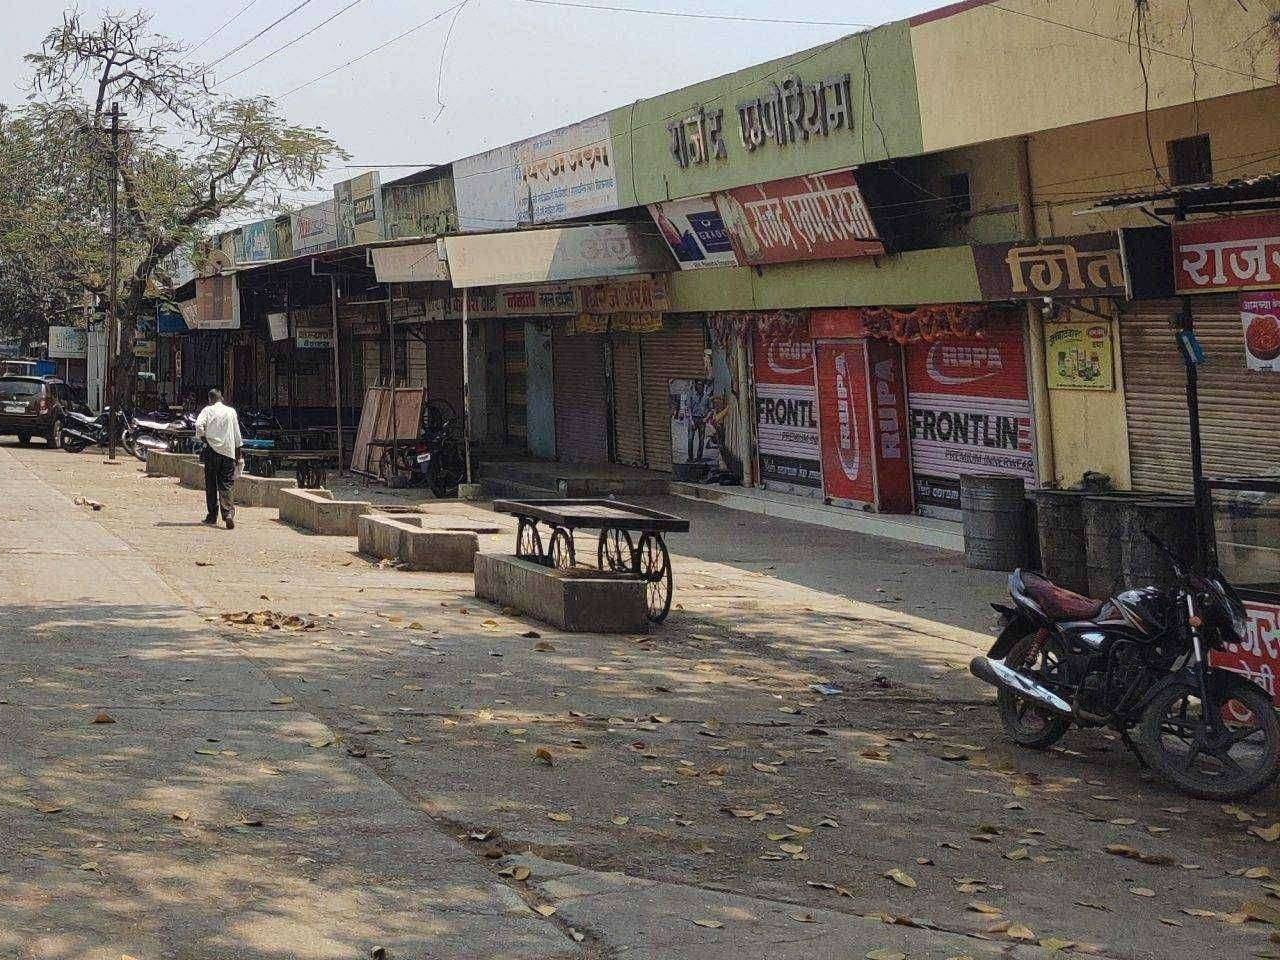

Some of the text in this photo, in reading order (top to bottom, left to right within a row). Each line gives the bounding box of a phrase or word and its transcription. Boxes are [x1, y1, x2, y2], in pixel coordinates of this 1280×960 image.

[1180, 236, 1280, 285] राज
[758, 398, 818, 427] FRONTL
[875, 359, 901, 458] RUPA
[910, 408, 1032, 452] FRONTLINE
